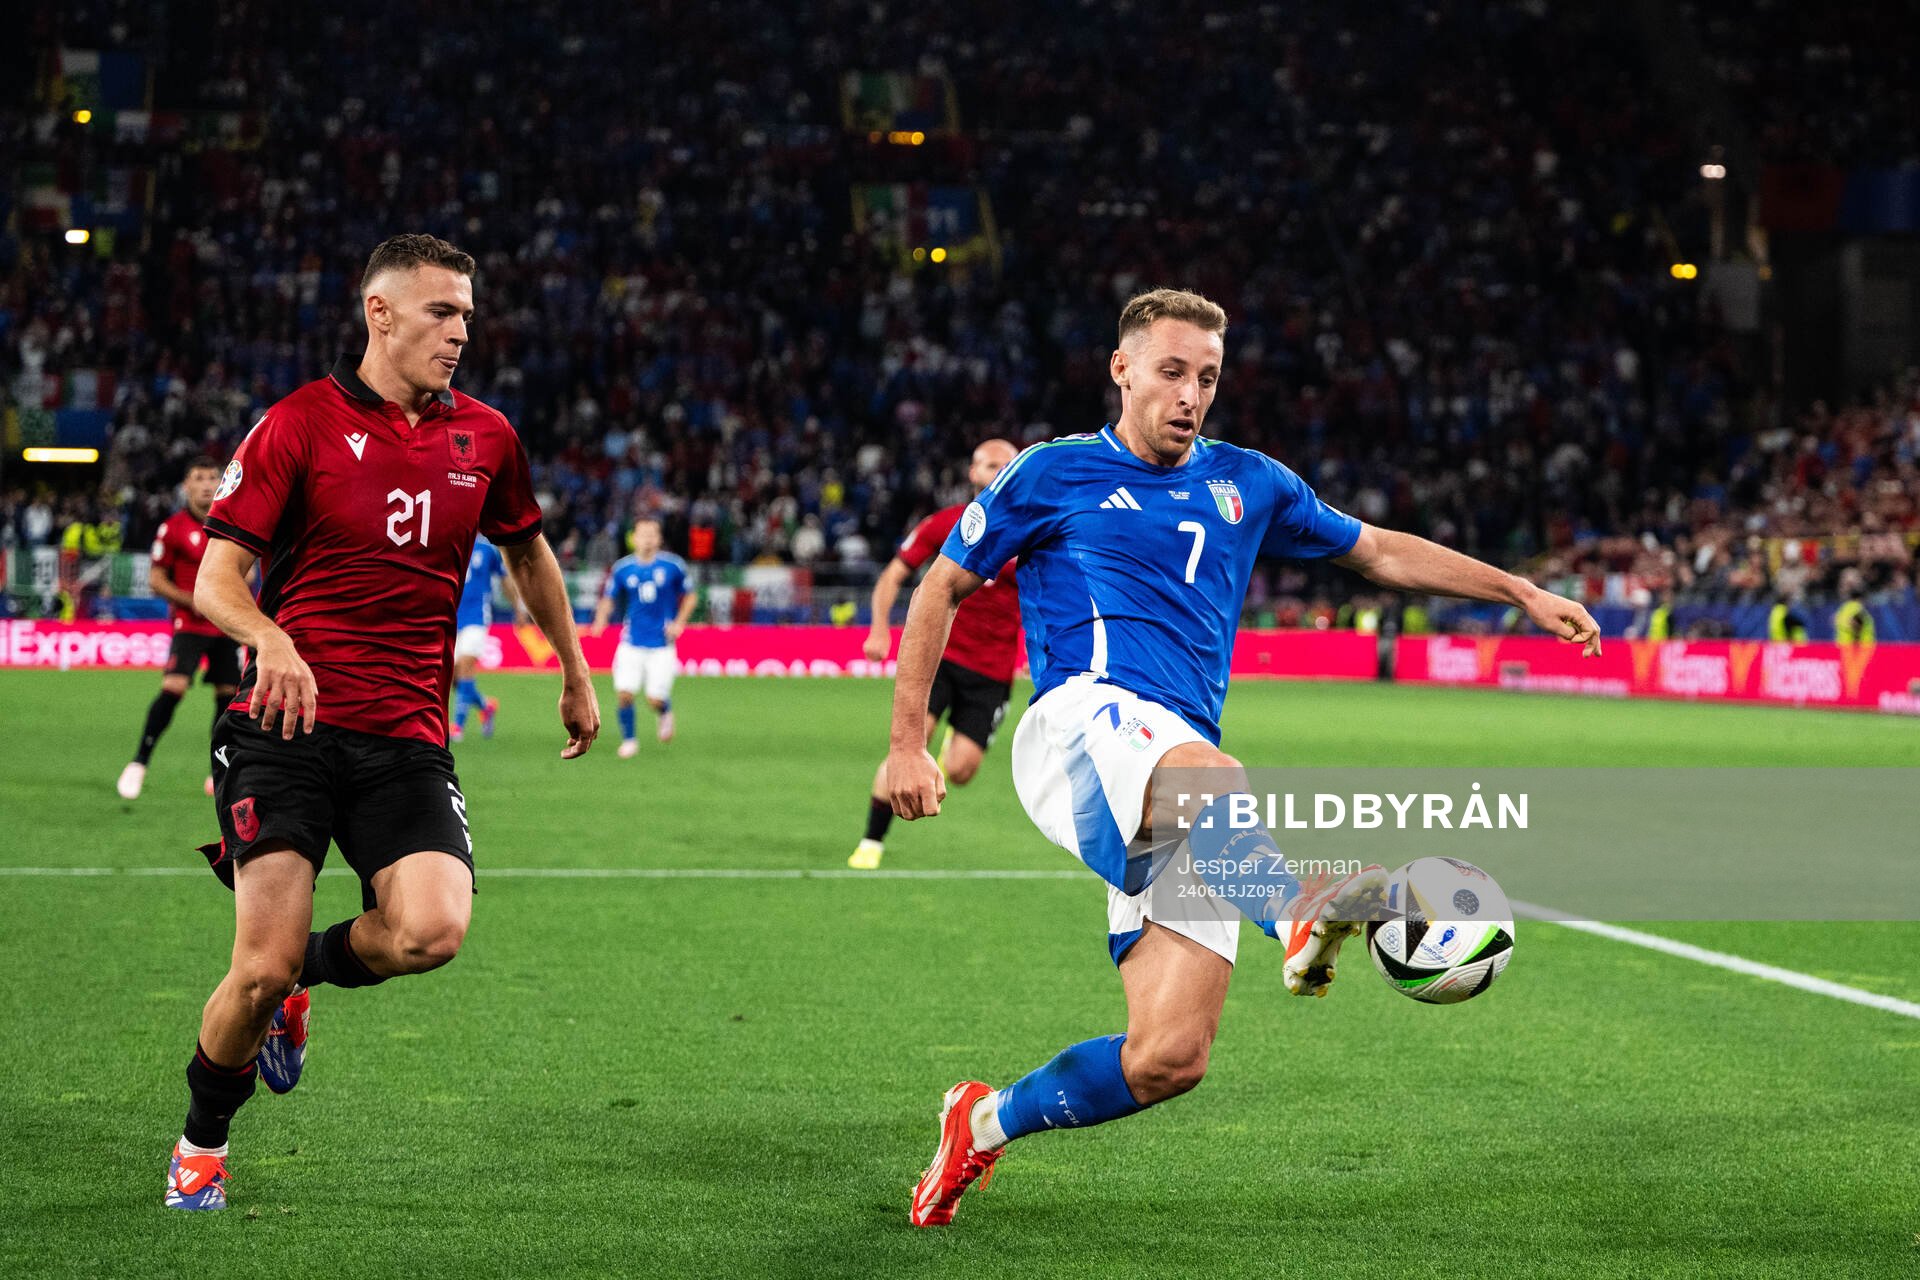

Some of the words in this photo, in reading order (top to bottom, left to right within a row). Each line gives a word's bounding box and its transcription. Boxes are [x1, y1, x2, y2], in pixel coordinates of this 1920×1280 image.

[1211, 486, 1237, 494] ITALIA
[387, 488, 431, 548] 21
[1177, 521, 1206, 584] 7
[1093, 702, 1121, 731] 7
